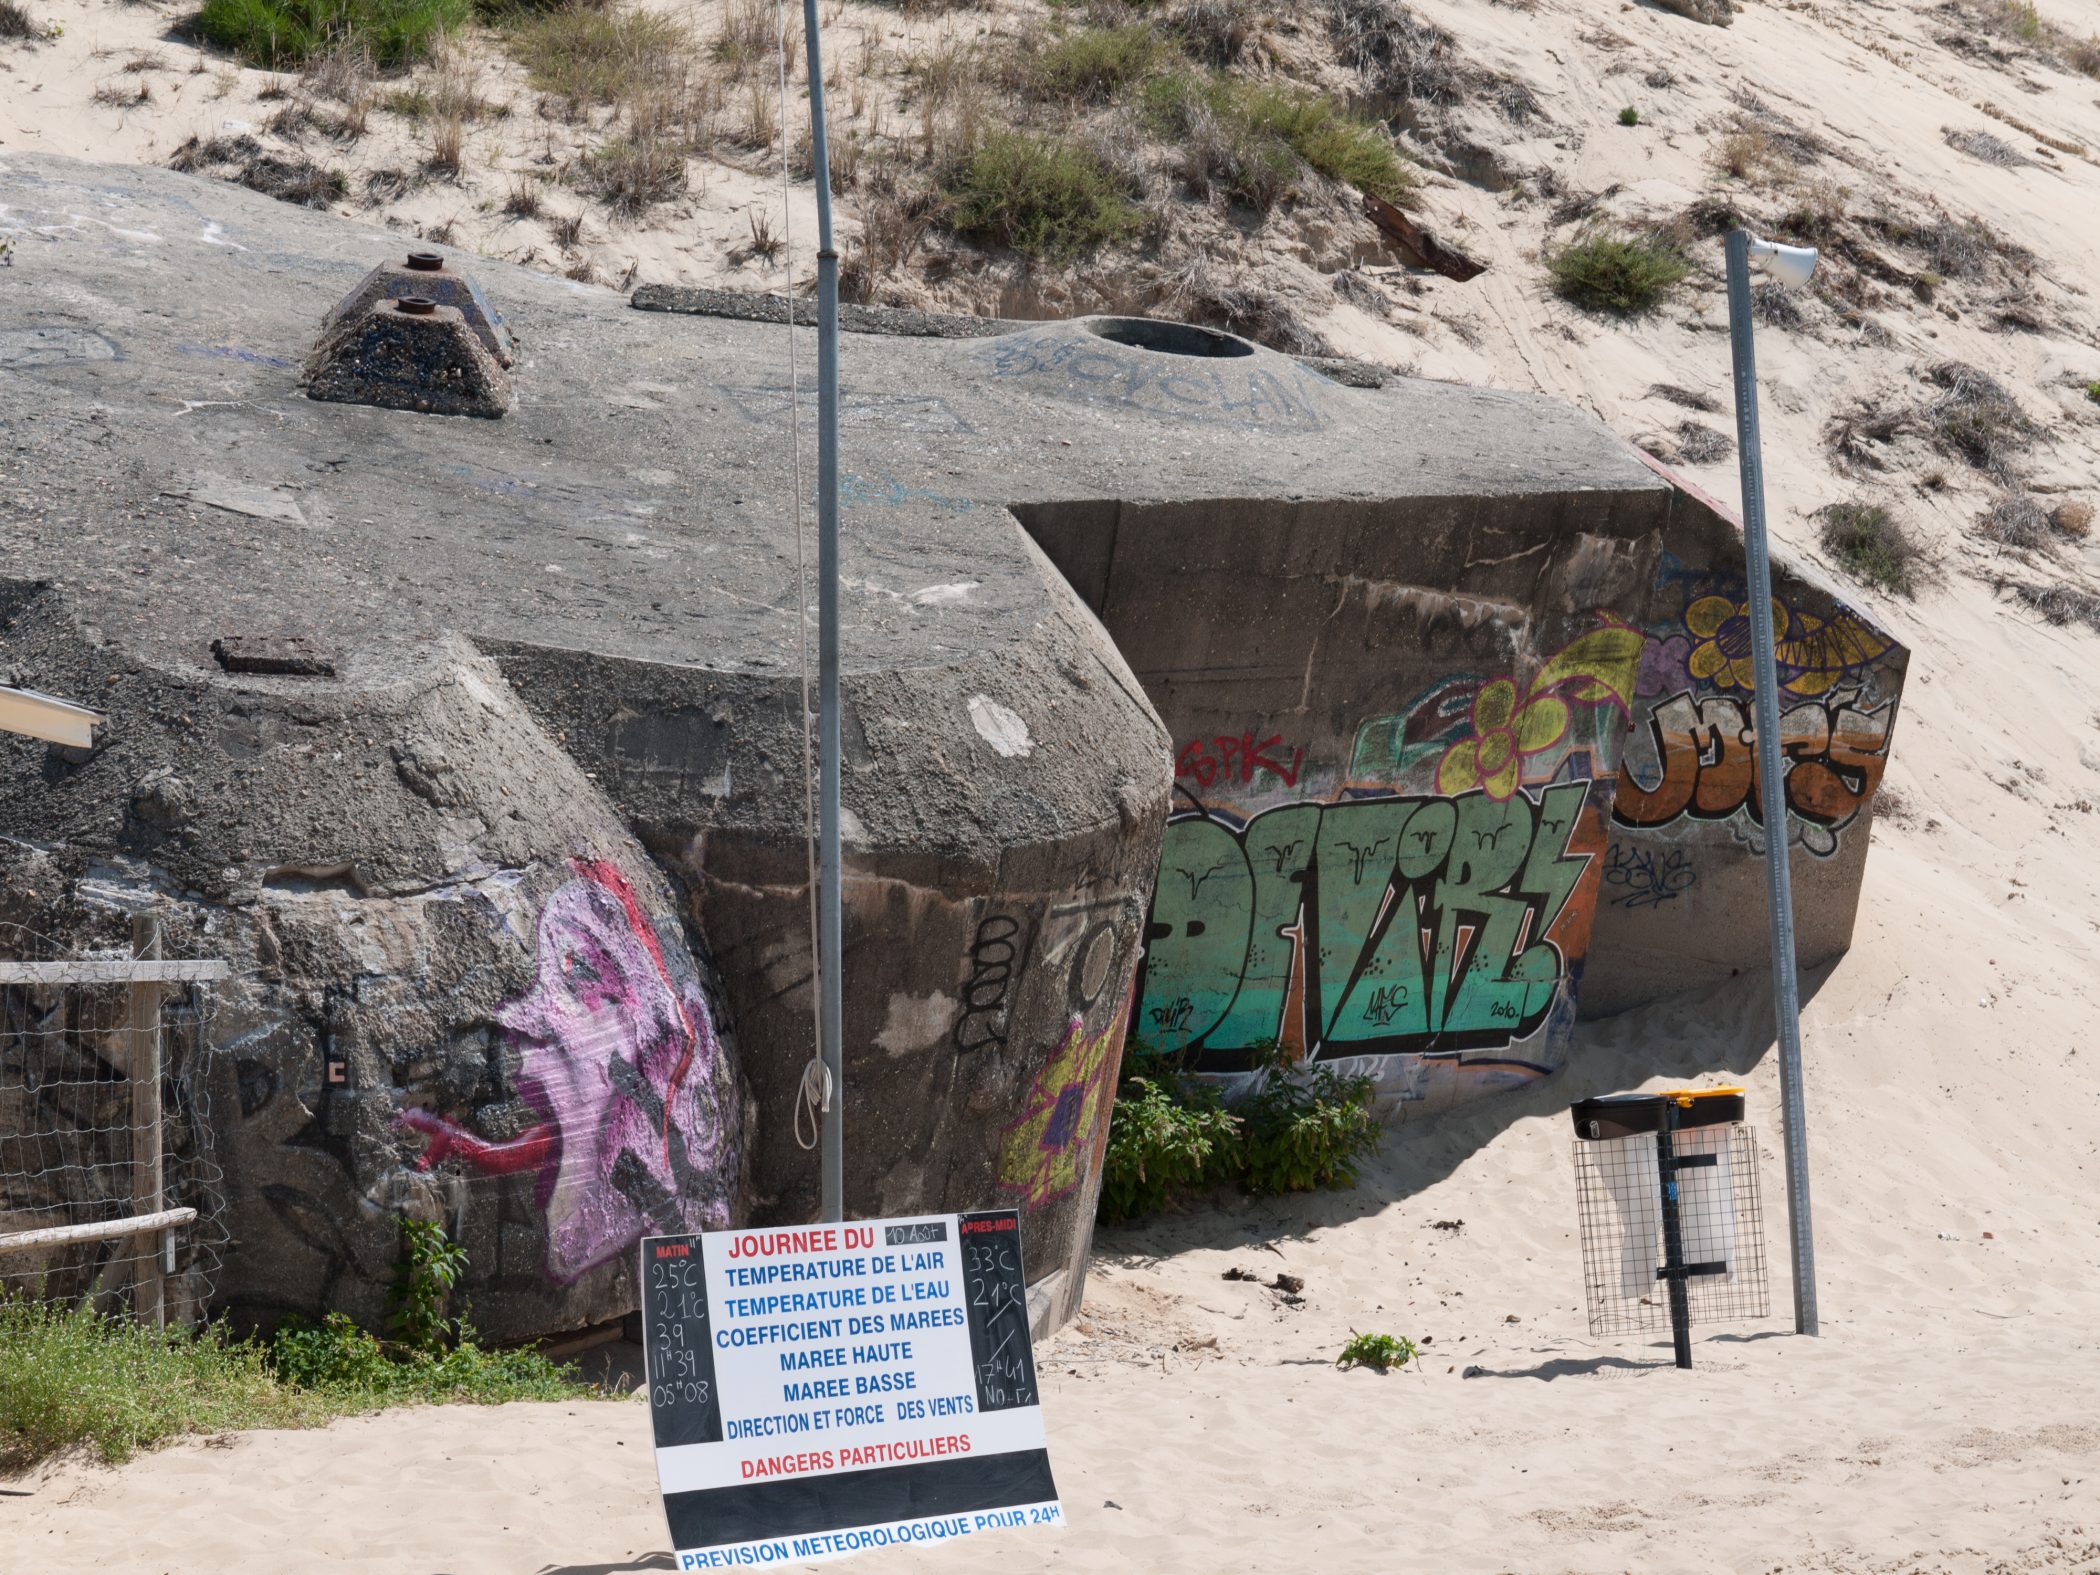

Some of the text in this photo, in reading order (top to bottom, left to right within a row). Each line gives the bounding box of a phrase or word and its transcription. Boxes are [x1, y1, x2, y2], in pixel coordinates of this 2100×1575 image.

[887, 1227, 905, 1245] 10
[961, 1218, 1017, 1234] APRES-MIDI
[657, 1244, 689, 1258] MATIN
[729, 1228, 874, 1259] JOURNEE DU
[726, 1251, 944, 1287] TEMPERATURE DE L'AIR
[725, 1280, 950, 1318] TEMPERATURE DE L'EAU
[656, 1323, 684, 1350] 39
[716, 1307, 964, 1348] COEFFICIENT DES MAREES
[780, 1341, 913, 1371] MAREE HAUTE
[783, 1371, 916, 1402] MAREE BASSE
[727, 1395, 973, 1440] DIRECTION ET FORCE DES VENTS
[741, 1434, 971, 1478] DANGERS PARTICULIERS
[682, 1543, 789, 1570] PREVISION
[794, 1518, 971, 1557] METEOROLOGIQUE
[975, 1510, 1027, 1530] POUR
